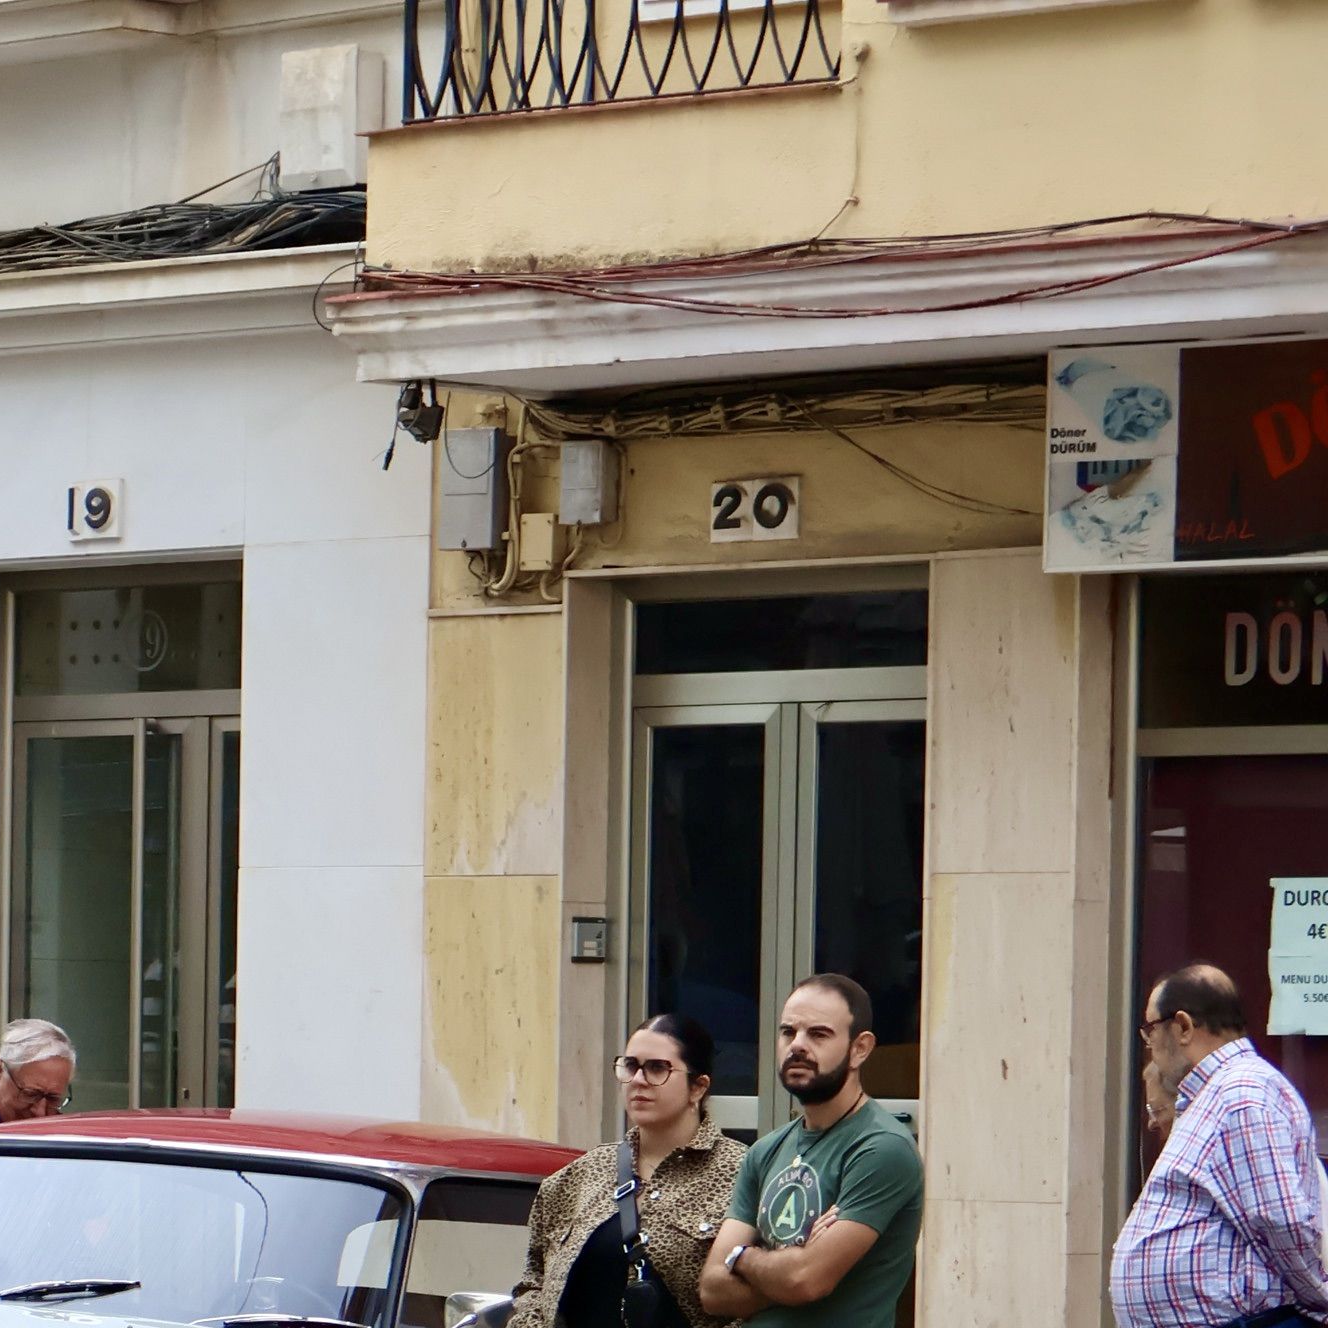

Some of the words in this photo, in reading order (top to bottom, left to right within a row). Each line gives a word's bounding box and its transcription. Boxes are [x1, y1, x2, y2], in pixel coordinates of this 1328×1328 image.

[67, 487, 111, 529] 19
[713, 484, 789, 530] 20
[1281, 974, 1311, 985] MENU
